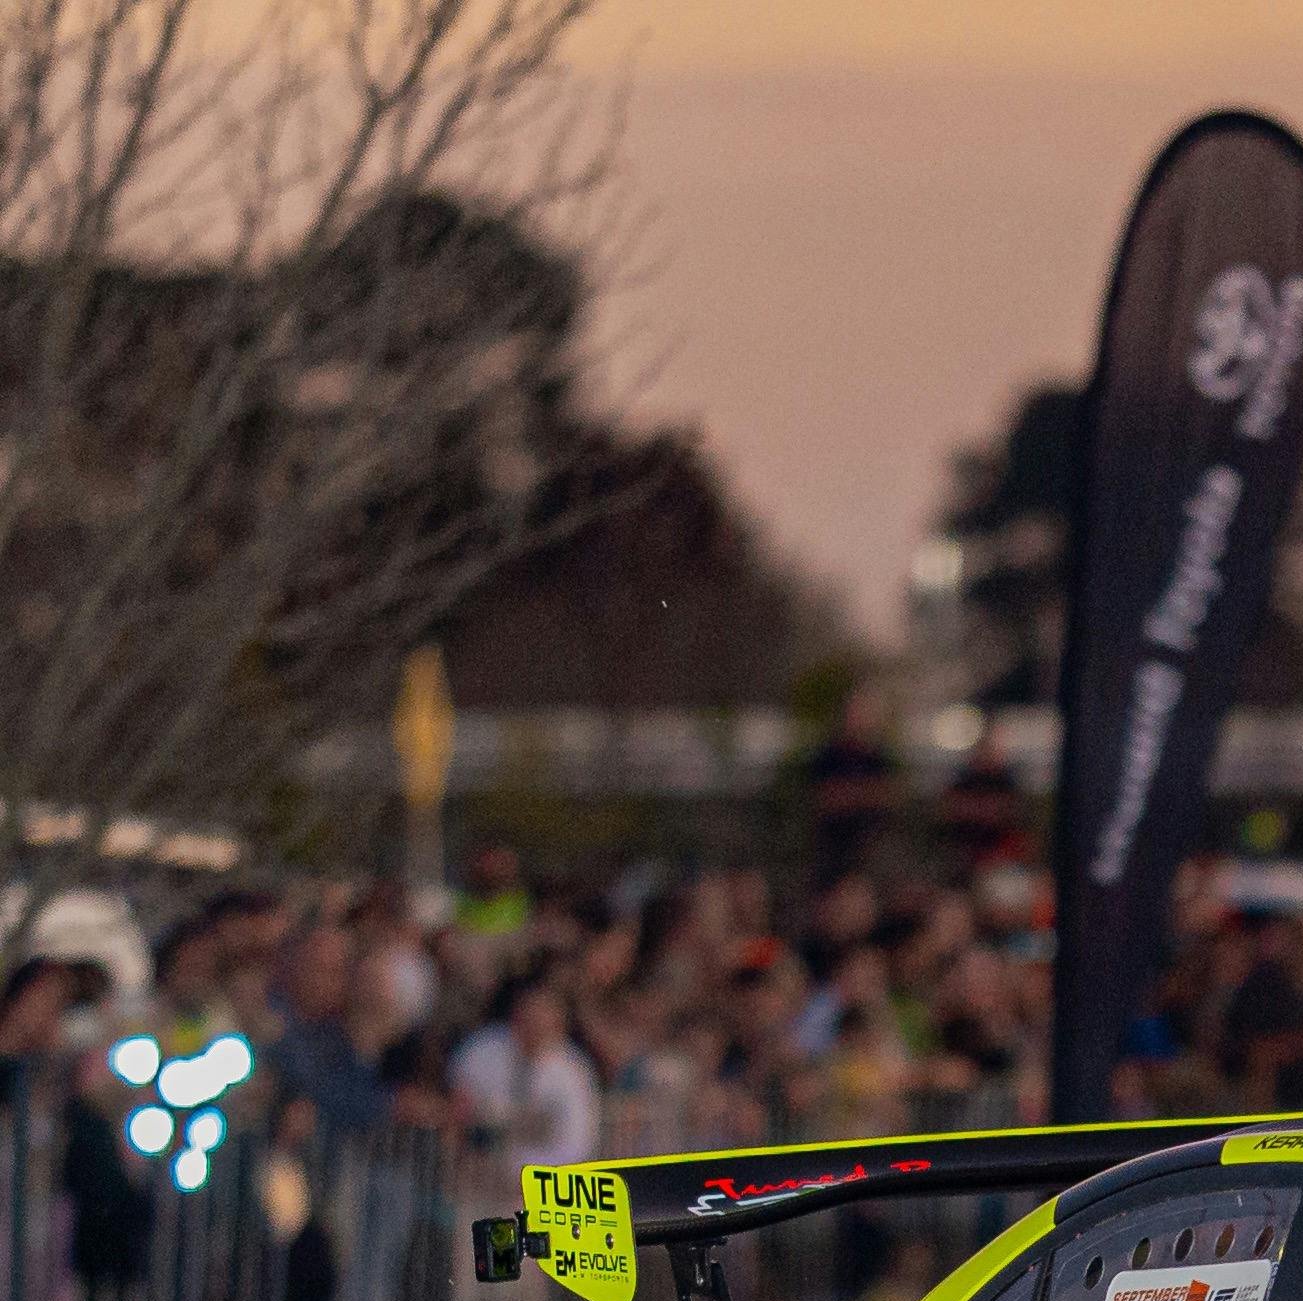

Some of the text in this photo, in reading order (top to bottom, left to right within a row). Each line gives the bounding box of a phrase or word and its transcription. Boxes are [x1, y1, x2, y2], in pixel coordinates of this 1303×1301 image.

[533, 1171, 616, 1212] TUNE
[540, 1211, 597, 1227] CORP
[579, 1252, 628, 1274] EVOLVE
